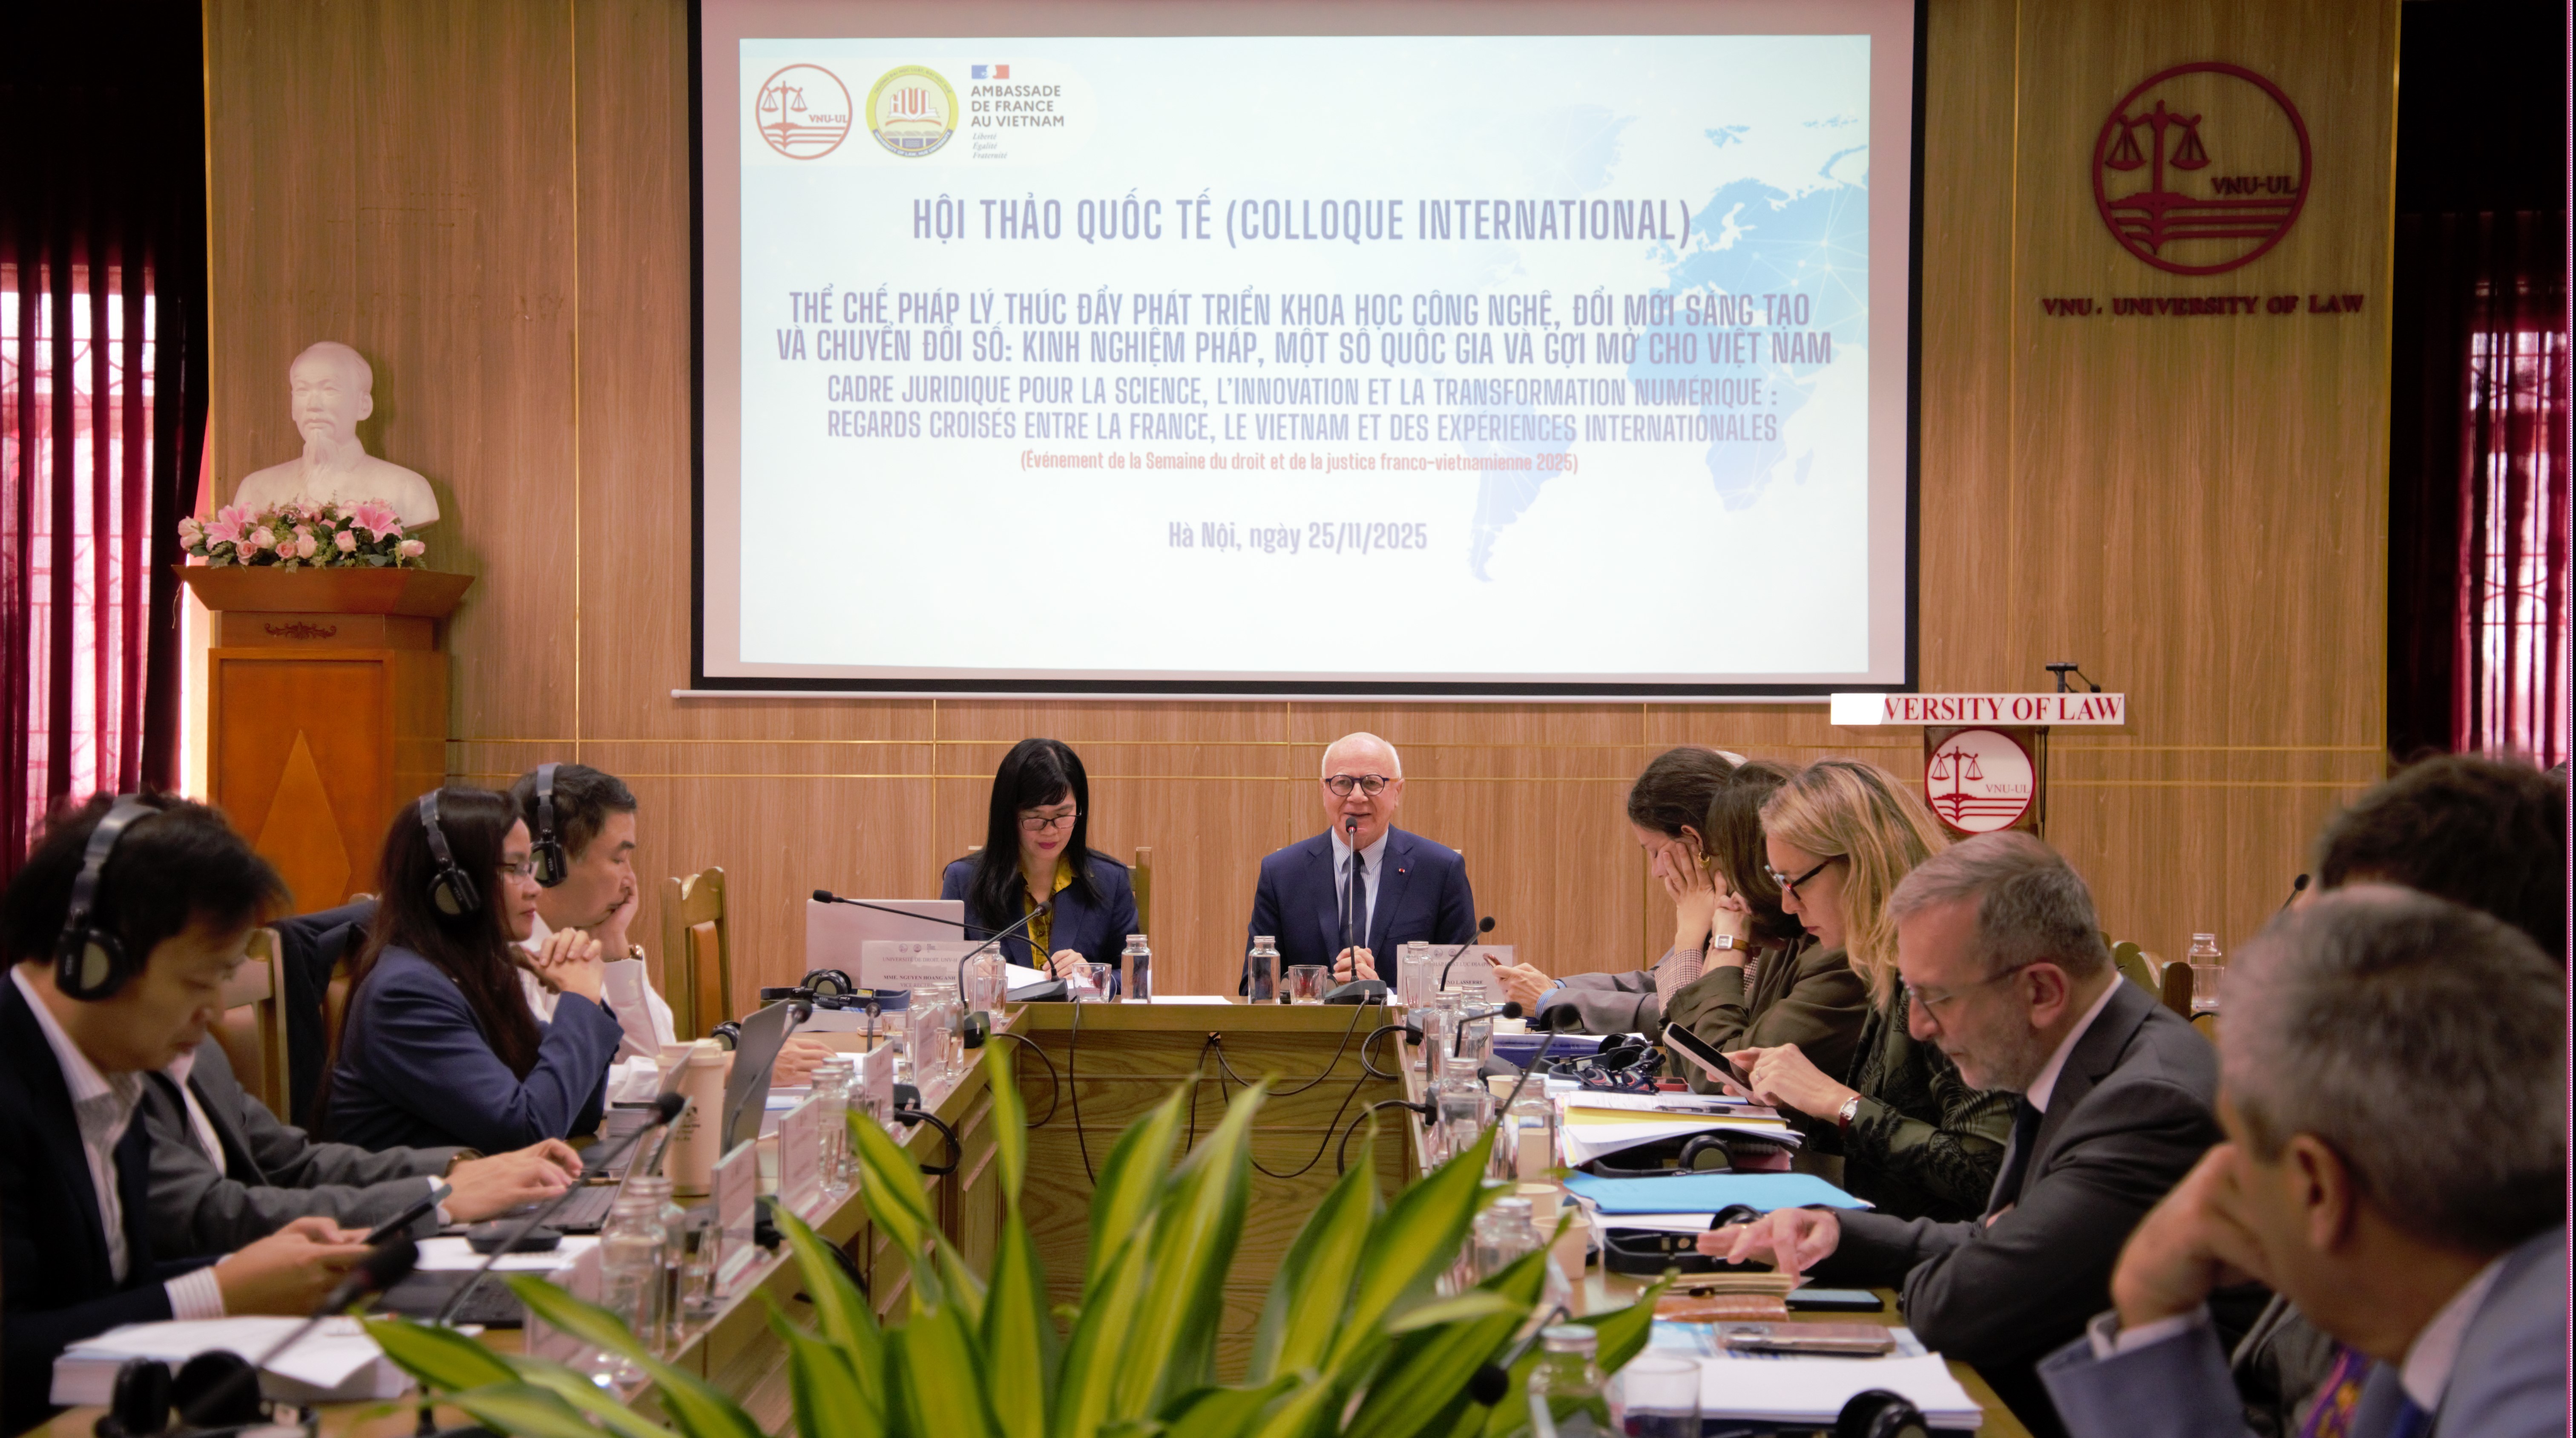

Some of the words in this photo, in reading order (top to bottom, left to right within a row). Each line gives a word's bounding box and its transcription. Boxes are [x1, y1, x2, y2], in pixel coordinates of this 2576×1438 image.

[971, 85, 1061, 97] AMBASSADE
[972, 101, 990, 112] DE
[995, 100, 1054, 112] FRANCE
[809, 115, 848, 123] VNU-UL
[971, 115, 991, 127] AU
[996, 115, 1064, 127] VIETNAM
[2211, 175, 2299, 195] VNU-UL
[914, 193, 964, 244] HỘI
[980, 192, 1061, 239] THẢO
[1077, 187, 1162, 244] QUỐC
[1176, 187, 1211, 239] TẾ
[1226, 199, 1403, 249] (COLLOQUE
[1419, 199, 1690, 249] INTERNATIONAL)
[789, 283, 834, 323] THỂ
[843, 282, 888, 323] CHẾ
[898, 288, 960, 324] PHÁP
[970, 288, 994, 324] LÝ
[1004, 288, 1067, 325] THÚC
[1077, 284, 1123, 325] ĐẨY
[1133, 289, 1192, 325] PHÁT
[1202, 285, 1270, 325] TRIỂN
[1281, 294, 1345, 326] KHOA
[1355, 294, 1403, 330] HỌC
[1413, 289, 1478, 326] CÔNG
[1489, 289, 1561, 331] NGHỆ,
[1573, 285, 1613, 327] ĐỔI
[1624, 289, 1675, 326] MỚI
[1685, 289, 1753, 327] SÁNG
[1762, 293, 1809, 330] TẠO
[2113, 296, 2258, 316] UNIVERSITY
[2266, 295, 2299, 314] OF
[2308, 294, 2364, 313] LAW
[776, 325, 806, 361] VÀ
[817, 321, 911, 361] CHUYỂN
[923, 321, 962, 362] ĐỔI
[973, 321, 1012, 362] SỐ:
[1023, 331, 1079, 362] KINH
[1091, 327, 1184, 367] NGHIỆM
[1196, 327, 1264, 368] PHÁP,
[1276, 327, 1329, 368] MỘT
[1456, 332, 1494, 364] GIA
[1504, 328, 1534, 364] VÀ
[1544, 332, 1585, 368] GỢI
[1596, 327, 1639, 364] MỞ
[1649, 332, 1697, 364] CHO
[1707, 327, 1761, 368] VIỆT
[1772, 331, 1831, 364] NAM
[828, 374, 894, 403] CADRE
[902, 375, 1010, 406] JURIDIQUE
[1019, 376, 1073, 404] POUR
[1082, 377, 1106, 404] LA
[1115, 377, 1208, 408] SCIENCE,
[1368, 378, 1392, 406] ET
[1400, 378, 1425, 406] LA
[1433, 378, 1625, 406] TRANSFORMATION
[1635, 375, 1762, 408] NUMÉRIQUE
[828, 410, 921, 437] REGARDS
[930, 407, 1016, 439] CROISÉS
[1025, 411, 1089, 439] ENTRE
[1097, 412, 1121, 440] LA
[1130, 412, 1216, 444] FRANCE,
[1225, 413, 1247, 440] LE
[1256, 413, 1348, 440] VIETNAM
[1358, 414, 1381, 441] ET
[1390, 414, 1429, 441] DES
[1438, 410, 1576, 442] EXPÉRIENCES
[1585, 414, 1777, 442] INTERNATIONALES
[1021, 448, 1104, 472] (Événement
[1108, 452, 1125, 469] de
[1130, 452, 1141, 469] la
[1146, 452, 1205, 469] Semaine
[1210, 452, 1227, 469] du
[1231, 452, 1265, 470] droit
[1270, 454, 1285, 470] et
[1289, 453, 1306, 470] de
[1311, 453, 1323, 470] la
[1325, 453, 1376, 474] justice
[1536, 453, 1578, 475] 2025)
[1169, 521, 1193, 548] Hà
[1202, 521, 1242, 552] Nội,
[1250, 522, 1301, 555] ngày
[1308, 522, 1427, 555] 25/11/2025
[1885, 697, 2005, 720] VERSITY
[2012, 697, 2051, 720] OF
[2058, 697, 2122, 720] LAW
[1986, 784, 2030, 793] VNU-UL
